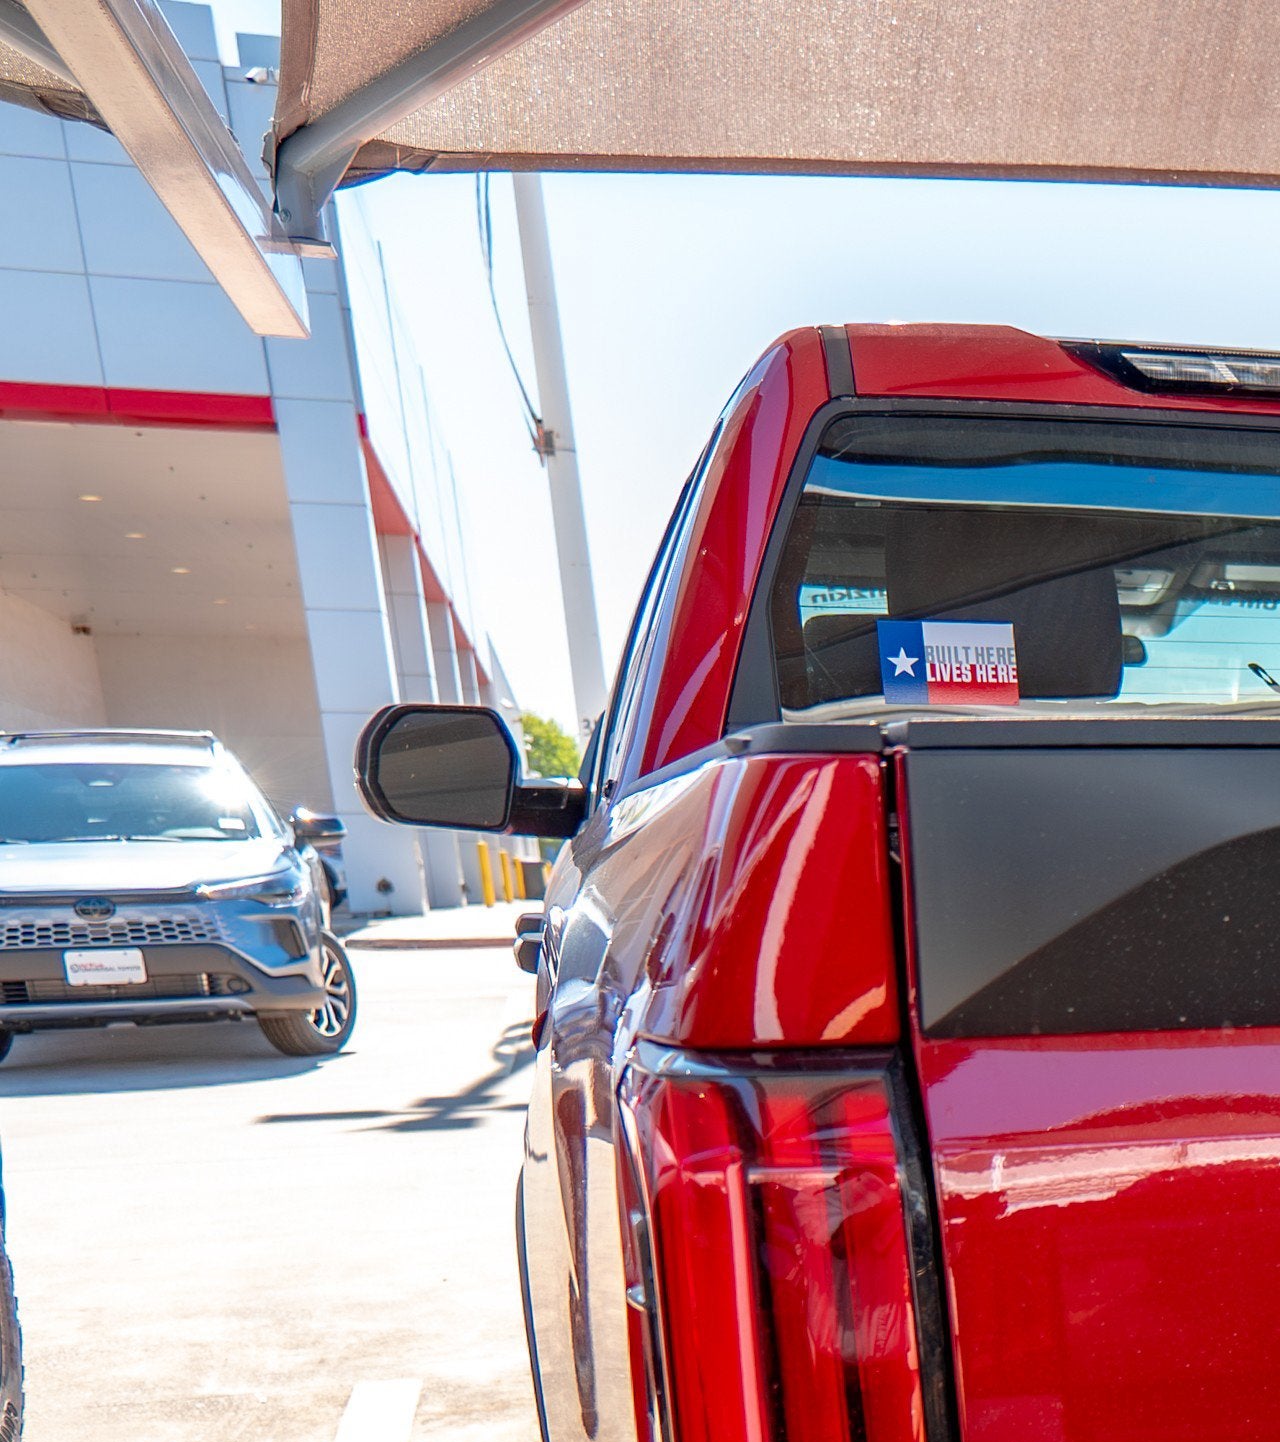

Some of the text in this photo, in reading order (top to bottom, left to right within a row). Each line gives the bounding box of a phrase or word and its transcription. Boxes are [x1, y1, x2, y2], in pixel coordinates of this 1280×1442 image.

[925, 645, 1015, 665] BUILT HERE
[926, 662, 1018, 683] LIVES HERE
